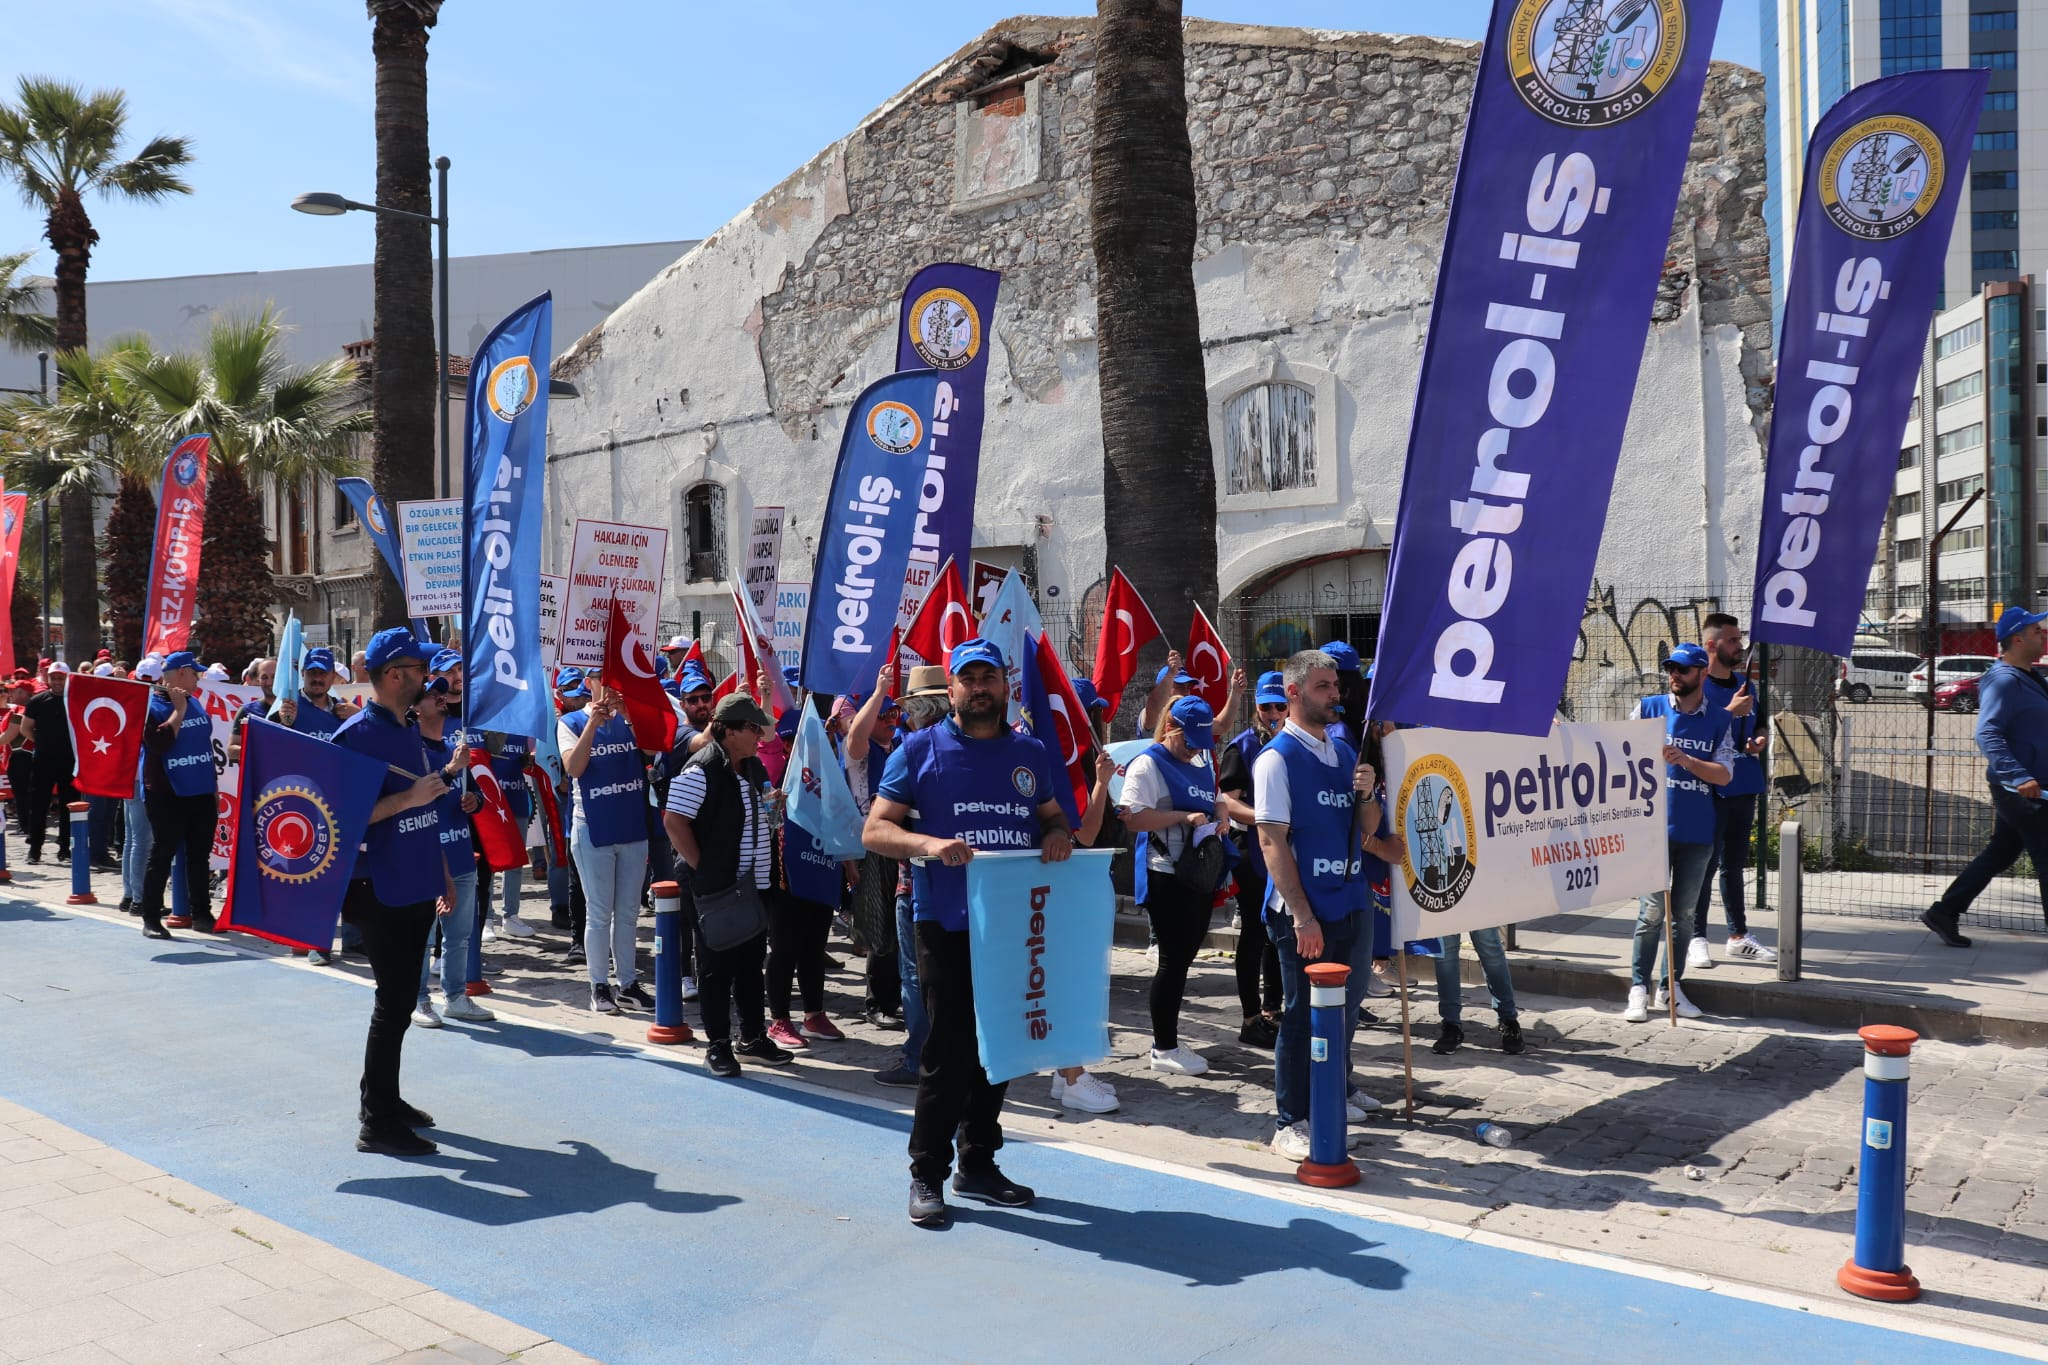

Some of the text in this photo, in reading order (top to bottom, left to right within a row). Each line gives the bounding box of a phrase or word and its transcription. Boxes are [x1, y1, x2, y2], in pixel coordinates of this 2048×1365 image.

[1525, 80, 1643, 124] PETROL-İŞ 1950
[1888, 215, 1915, 235] 1950
[1429, 151, 1612, 704] petrol-iş
[1761, 256, 1892, 628] petrol-iş
[443, 508, 453, 516] VE
[594, 530, 649, 550] HAKLARI İÇİN
[160, 498, 198, 640] TEZ-KOOP-İŞ
[598, 550, 639, 569] ÖLENLERE
[832, 474, 902, 654] petrol-iş
[573, 571, 608, 588] MİNNET
[765, 569, 775, 586] DA
[575, 618, 599, 632] SAYGI
[1484, 740, 1658, 838] petrol-iş
[953, 802, 1030, 818] petrol-iş
[1497, 823, 1524, 838] Türkiye
[1525, 818, 1546, 832] Petrol
[1547, 816, 1568, 831] Kimya
[1569, 811, 1588, 826] Lastik
[1612, 807, 1642, 820] Sendikası
[1455, 869, 1472, 896] 1950
[1566, 865, 1599, 891] 2021
